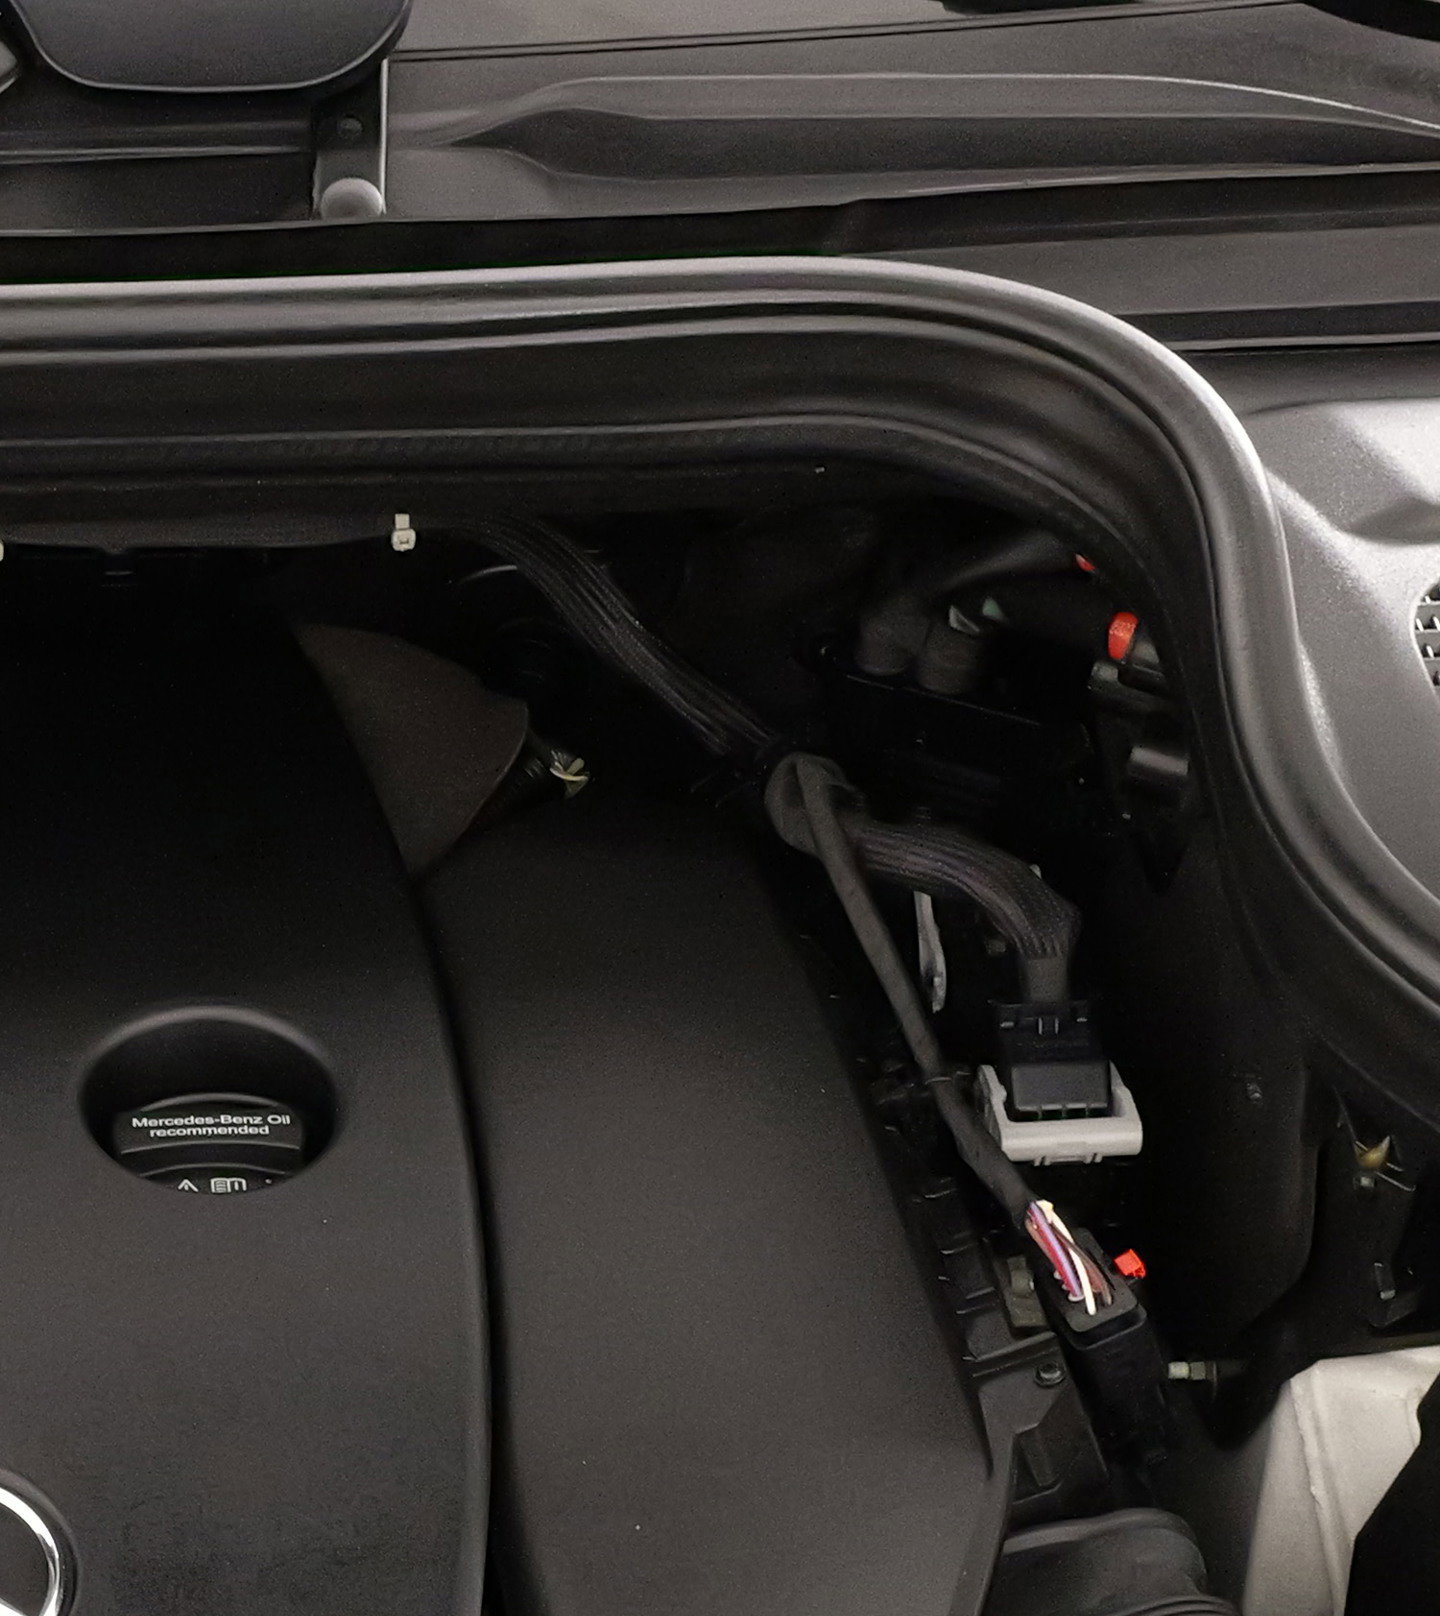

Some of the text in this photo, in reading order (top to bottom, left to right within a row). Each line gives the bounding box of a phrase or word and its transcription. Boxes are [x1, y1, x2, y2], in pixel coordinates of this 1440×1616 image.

[131, 1113, 291, 1128] Mercedes-Benz Oil
[149, 1125, 270, 1137] recommended
